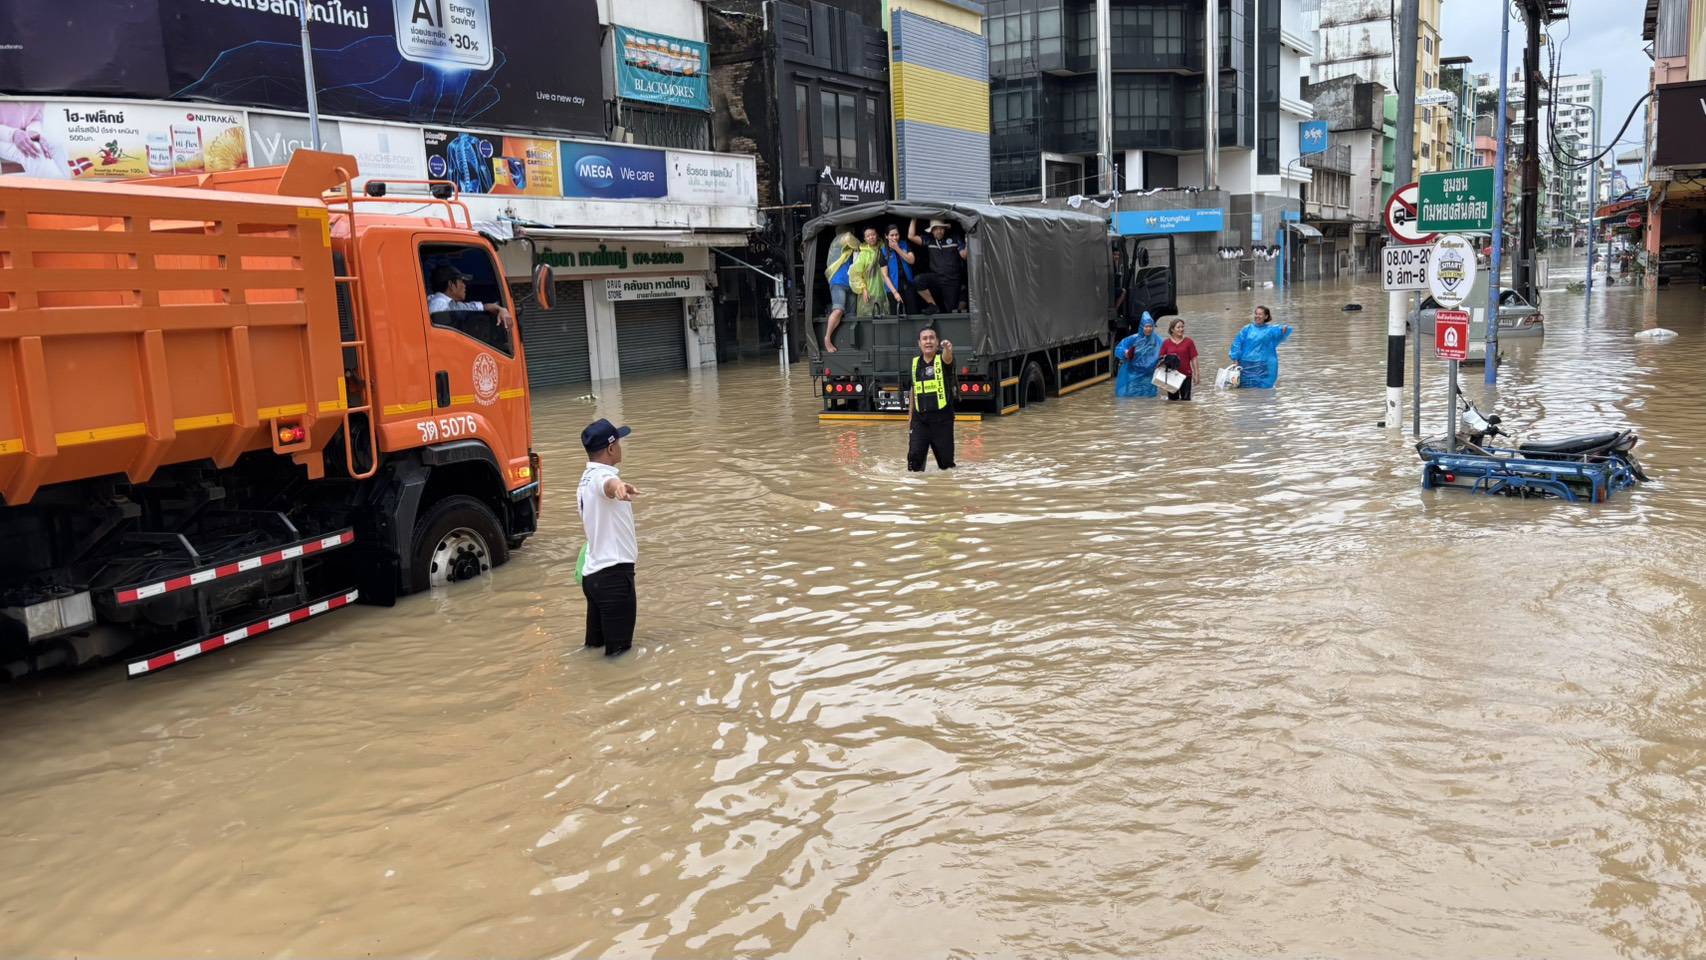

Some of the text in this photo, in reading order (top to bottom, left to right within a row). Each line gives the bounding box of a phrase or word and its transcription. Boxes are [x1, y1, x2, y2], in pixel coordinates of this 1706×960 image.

[411, 0, 443, 28] AI
[449, 3, 475, 17] Energy
[450, 15, 476, 29] Saving
[448, 33, 479, 51] +30%
[634, 78, 695, 98] BLACKMORES
[536, 91, 550, 100] Live
[557, 95, 571, 103] new
[572, 95, 585, 106] day
[63, 108, 125, 124] ไฮ-เฟล็กซ์
[195, 114, 238, 124] NUTRAKAL
[579, 164, 655, 182] MEGA We care
[1442, 177, 1468, 198] ชุมชน
[1159, 215, 1191, 224] Krungthai
[1422, 195, 1488, 228] กิมหยงสันติสุข
[1441, 261, 1462, 269] SMART
[606, 280, 622, 289] DRUG
[623, 277, 690, 291] คลังยา หาดใหญ่
[1386, 268, 1425, 285] 8 am-8
[607, 290, 622, 299] STORE
[935, 361, 945, 400] POLICE
[440, 415, 477, 438] 5076
